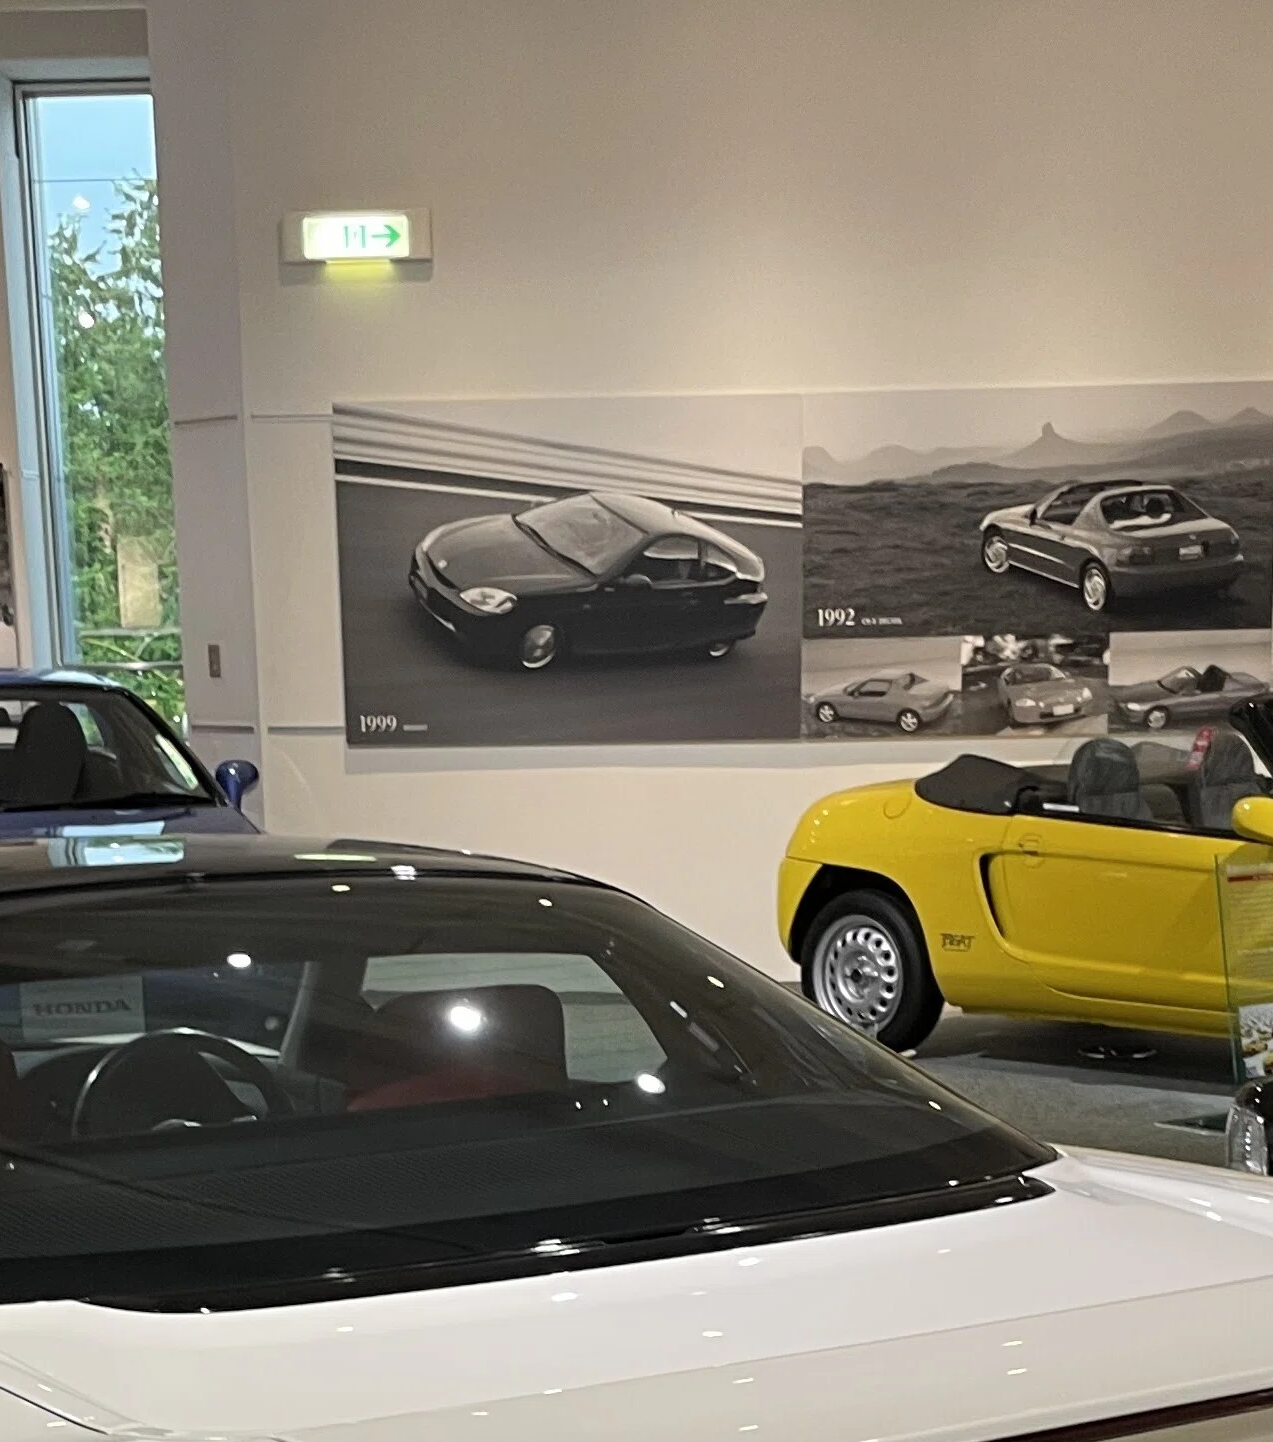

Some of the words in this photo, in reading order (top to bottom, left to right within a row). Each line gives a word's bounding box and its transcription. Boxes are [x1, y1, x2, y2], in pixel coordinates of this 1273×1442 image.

[817, 608, 856, 627] 1992
[359, 714, 398, 733] 1999
[33, 999, 132, 1016] HONDA
